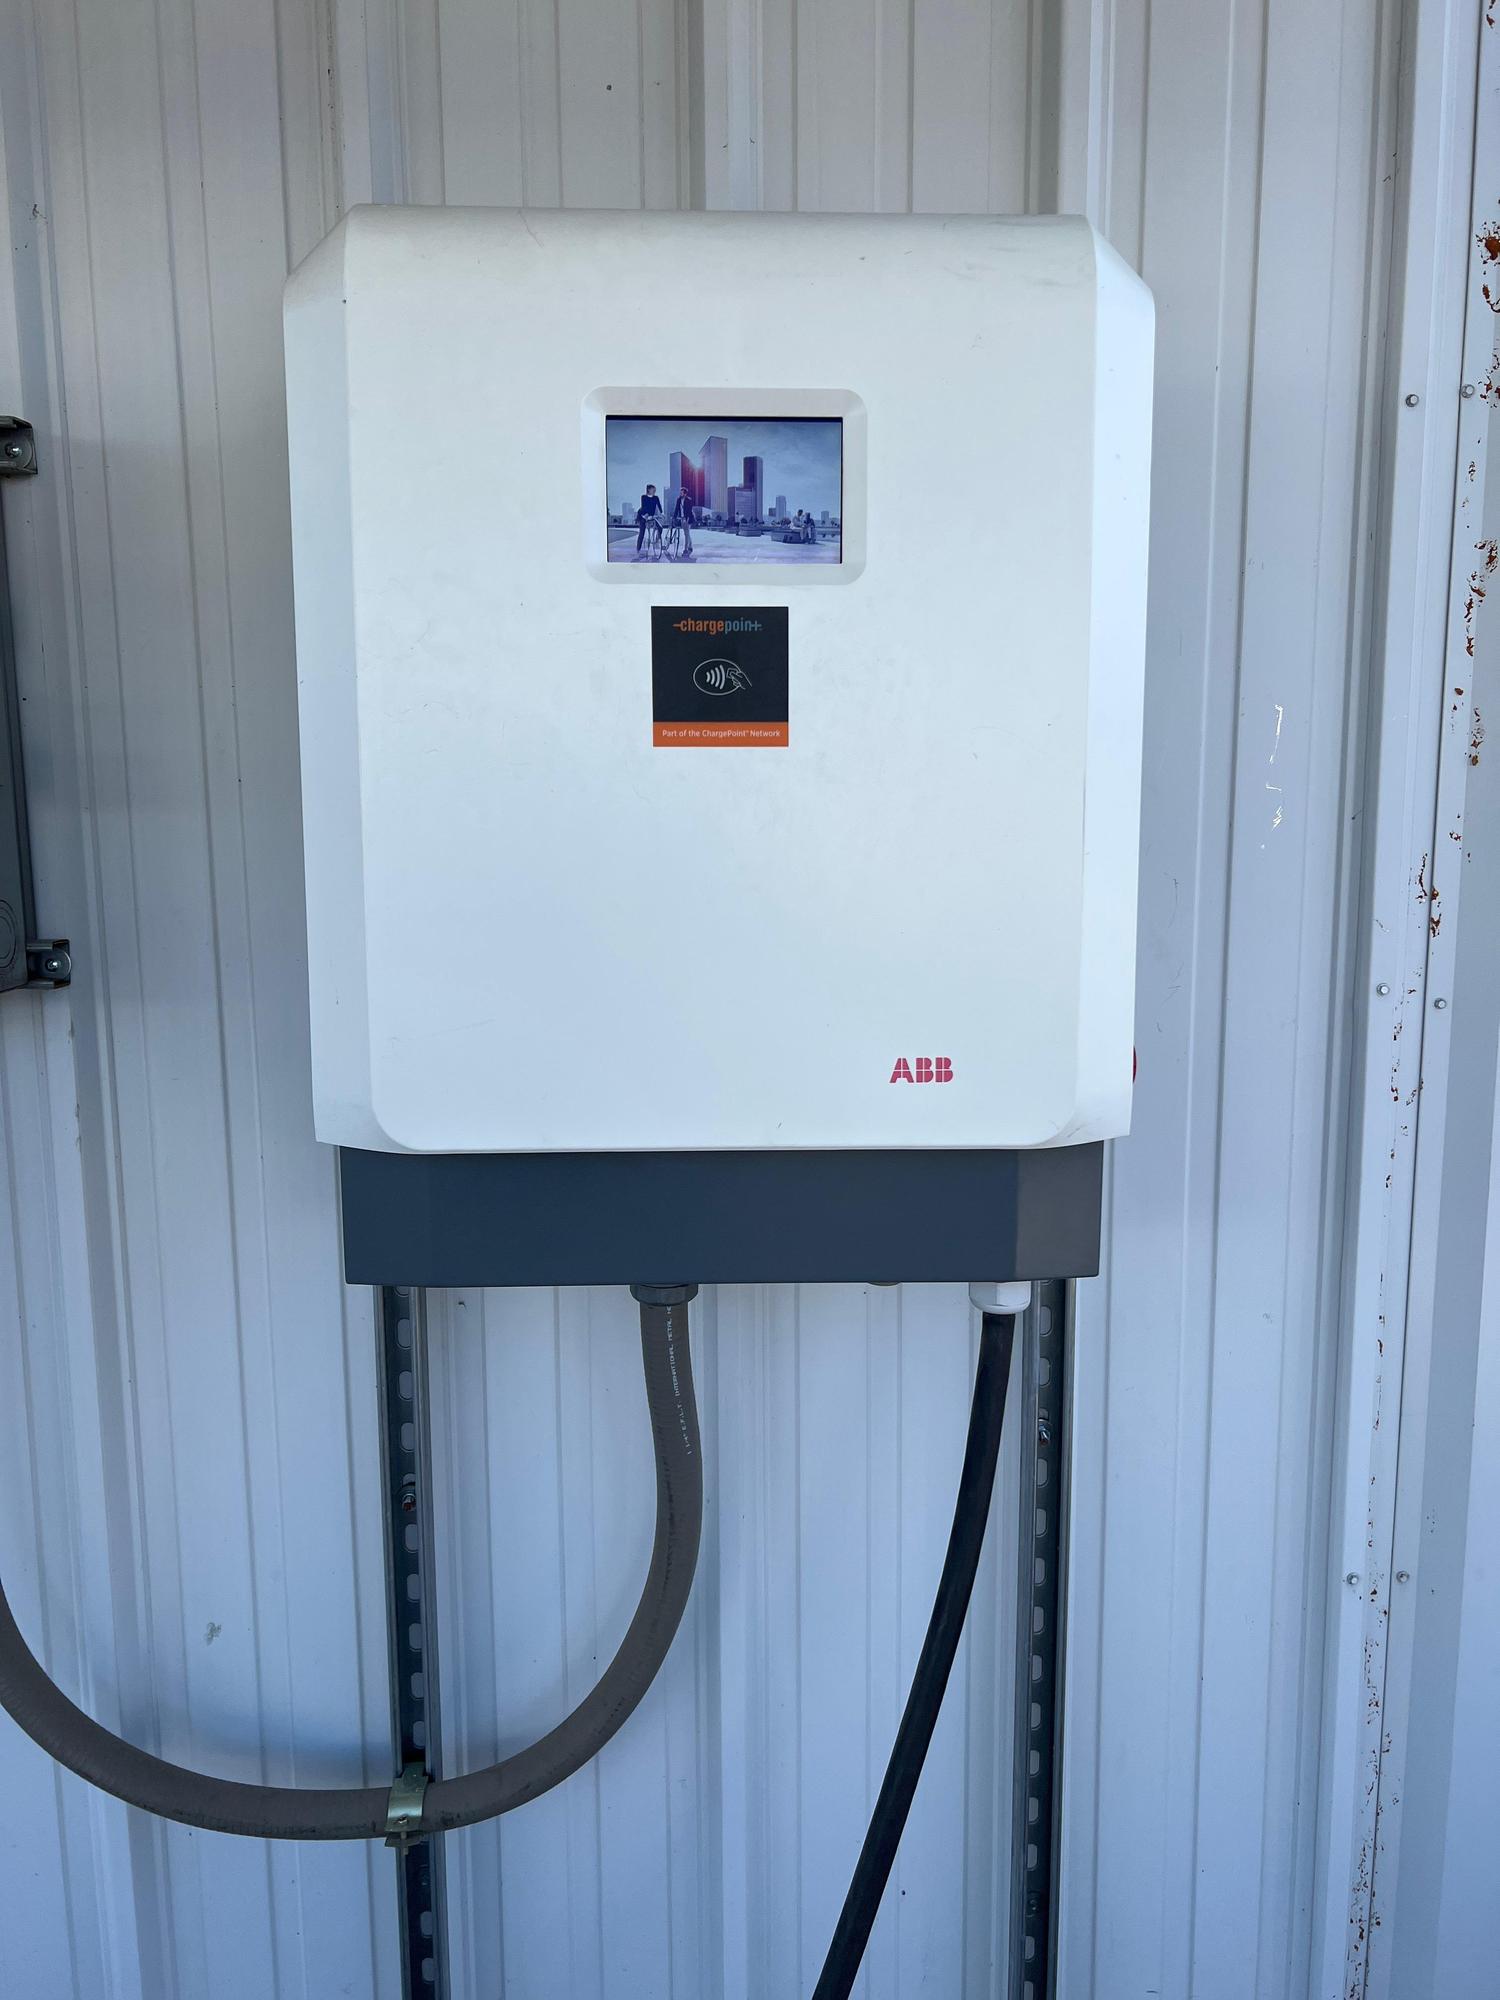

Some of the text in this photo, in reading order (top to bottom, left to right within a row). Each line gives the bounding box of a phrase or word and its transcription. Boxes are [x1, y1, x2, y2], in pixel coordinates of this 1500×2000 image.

[662, 729, 677, 737] Part
[679, 729, 687, 737] of
[688, 729, 700, 737] the
[750, 729, 781, 737] Network
[889, 1057, 954, 1083] ABB
[668, 1343, 680, 1397] INTERNATIONAL
